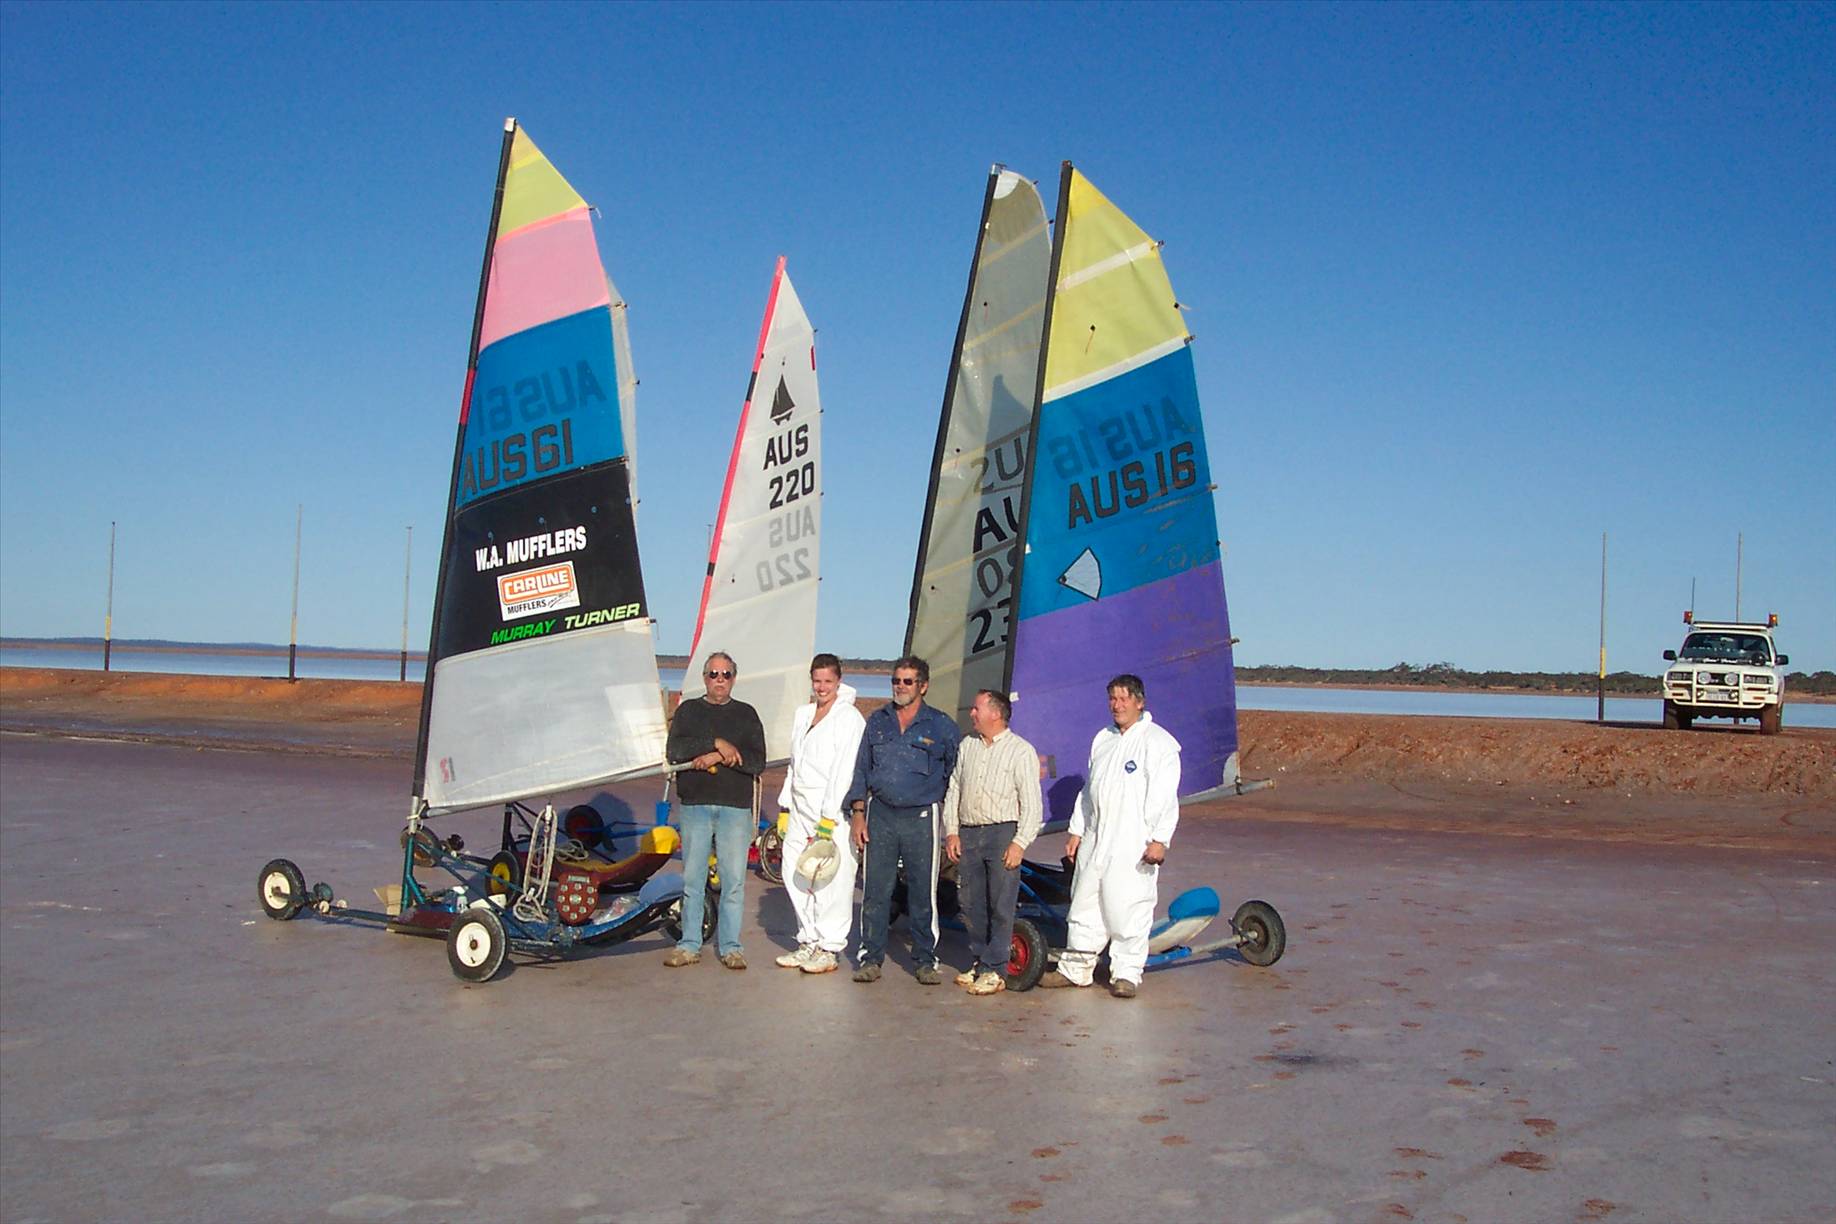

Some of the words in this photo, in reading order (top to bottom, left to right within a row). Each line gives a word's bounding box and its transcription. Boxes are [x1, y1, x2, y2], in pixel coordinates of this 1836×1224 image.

[462, 418, 573, 499] AUS61
[763, 423, 809, 470] AUS
[769, 461, 815, 510] 220
[475, 545, 504, 572] W.A.
[507, 525, 587, 564] MUFFLERS
[504, 569, 570, 599] CARLINE
[507, 600, 547, 615] MUFFLERS
[490, 619, 555, 645] MURRAY
[564, 602, 640, 630] TURNER
